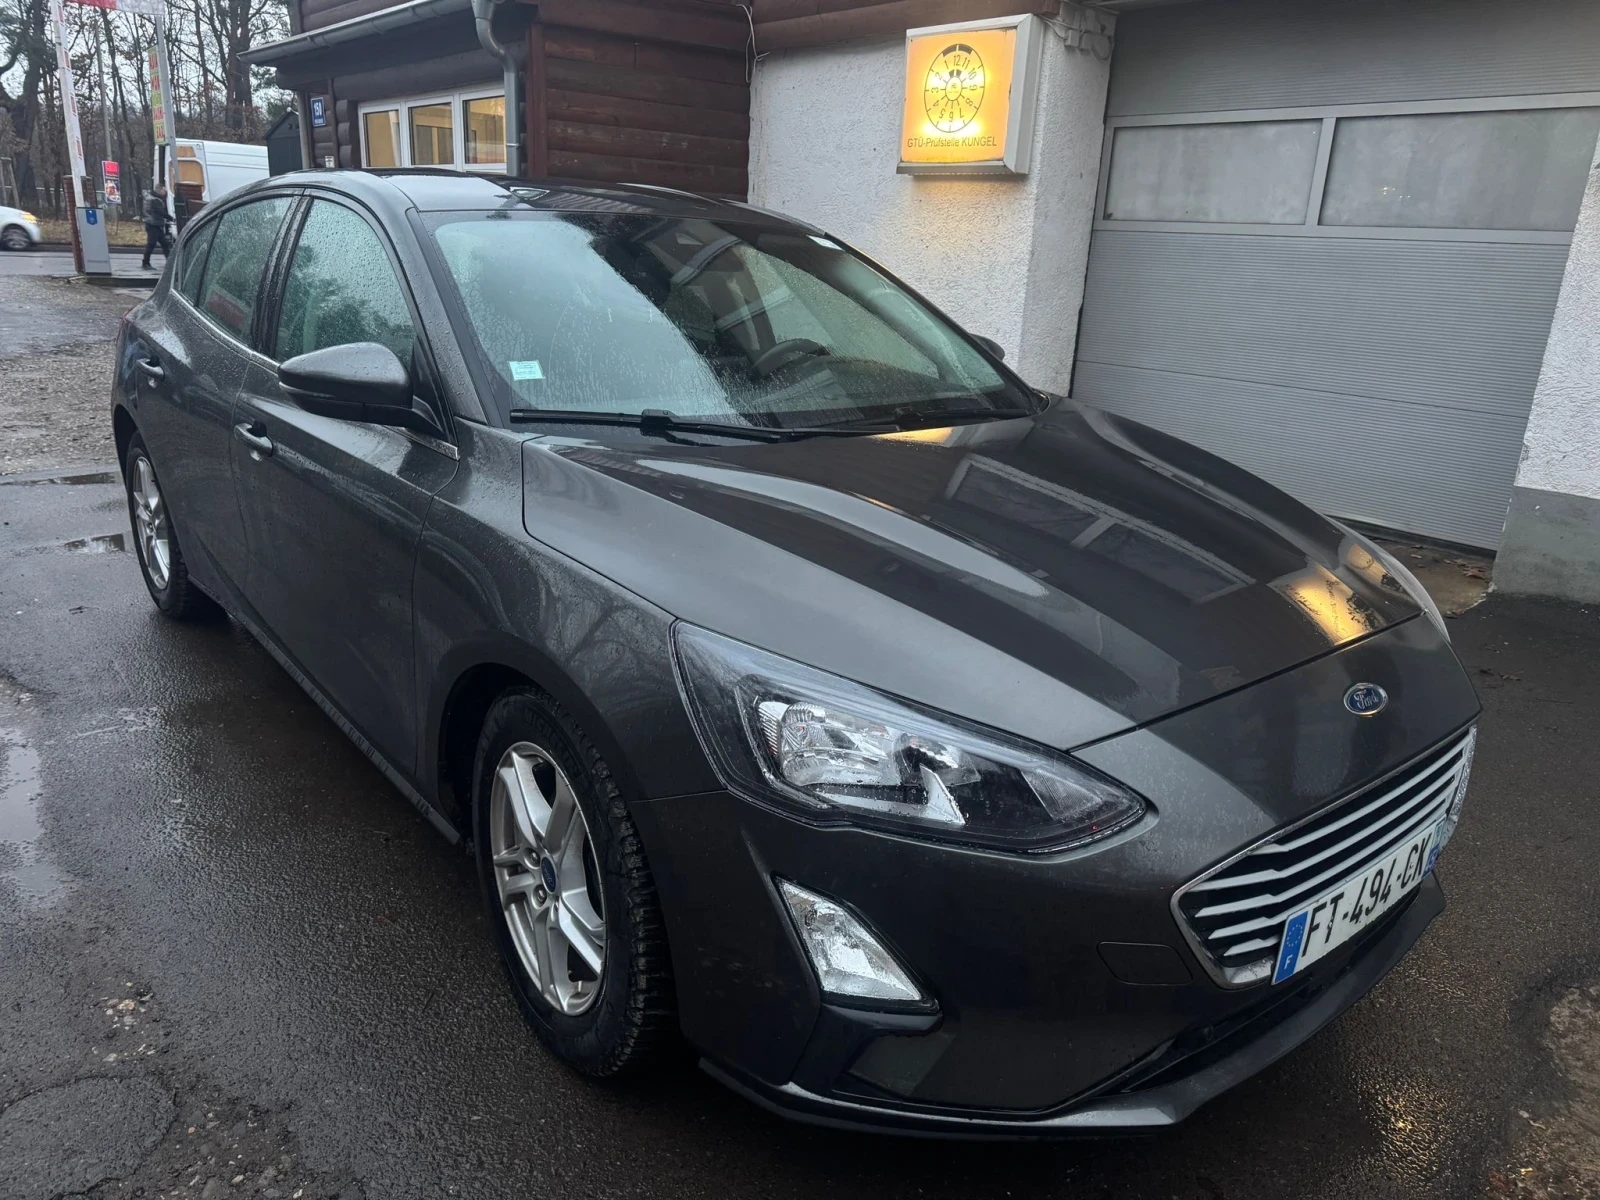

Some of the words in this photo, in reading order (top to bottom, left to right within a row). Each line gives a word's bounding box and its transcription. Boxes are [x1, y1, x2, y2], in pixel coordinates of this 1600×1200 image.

[953, 54, 960, 66] 12
[962, 57, 971, 69] 11
[935, 72, 943, 80] 2
[968, 67, 977, 80] 10
[965, 98, 973, 106] 8
[939, 108, 946, 118] 5
[1353, 689, 1379, 710] Ford
[1301, 832, 1433, 957] FT-494-CK
[1283, 955, 1292, 970] F
